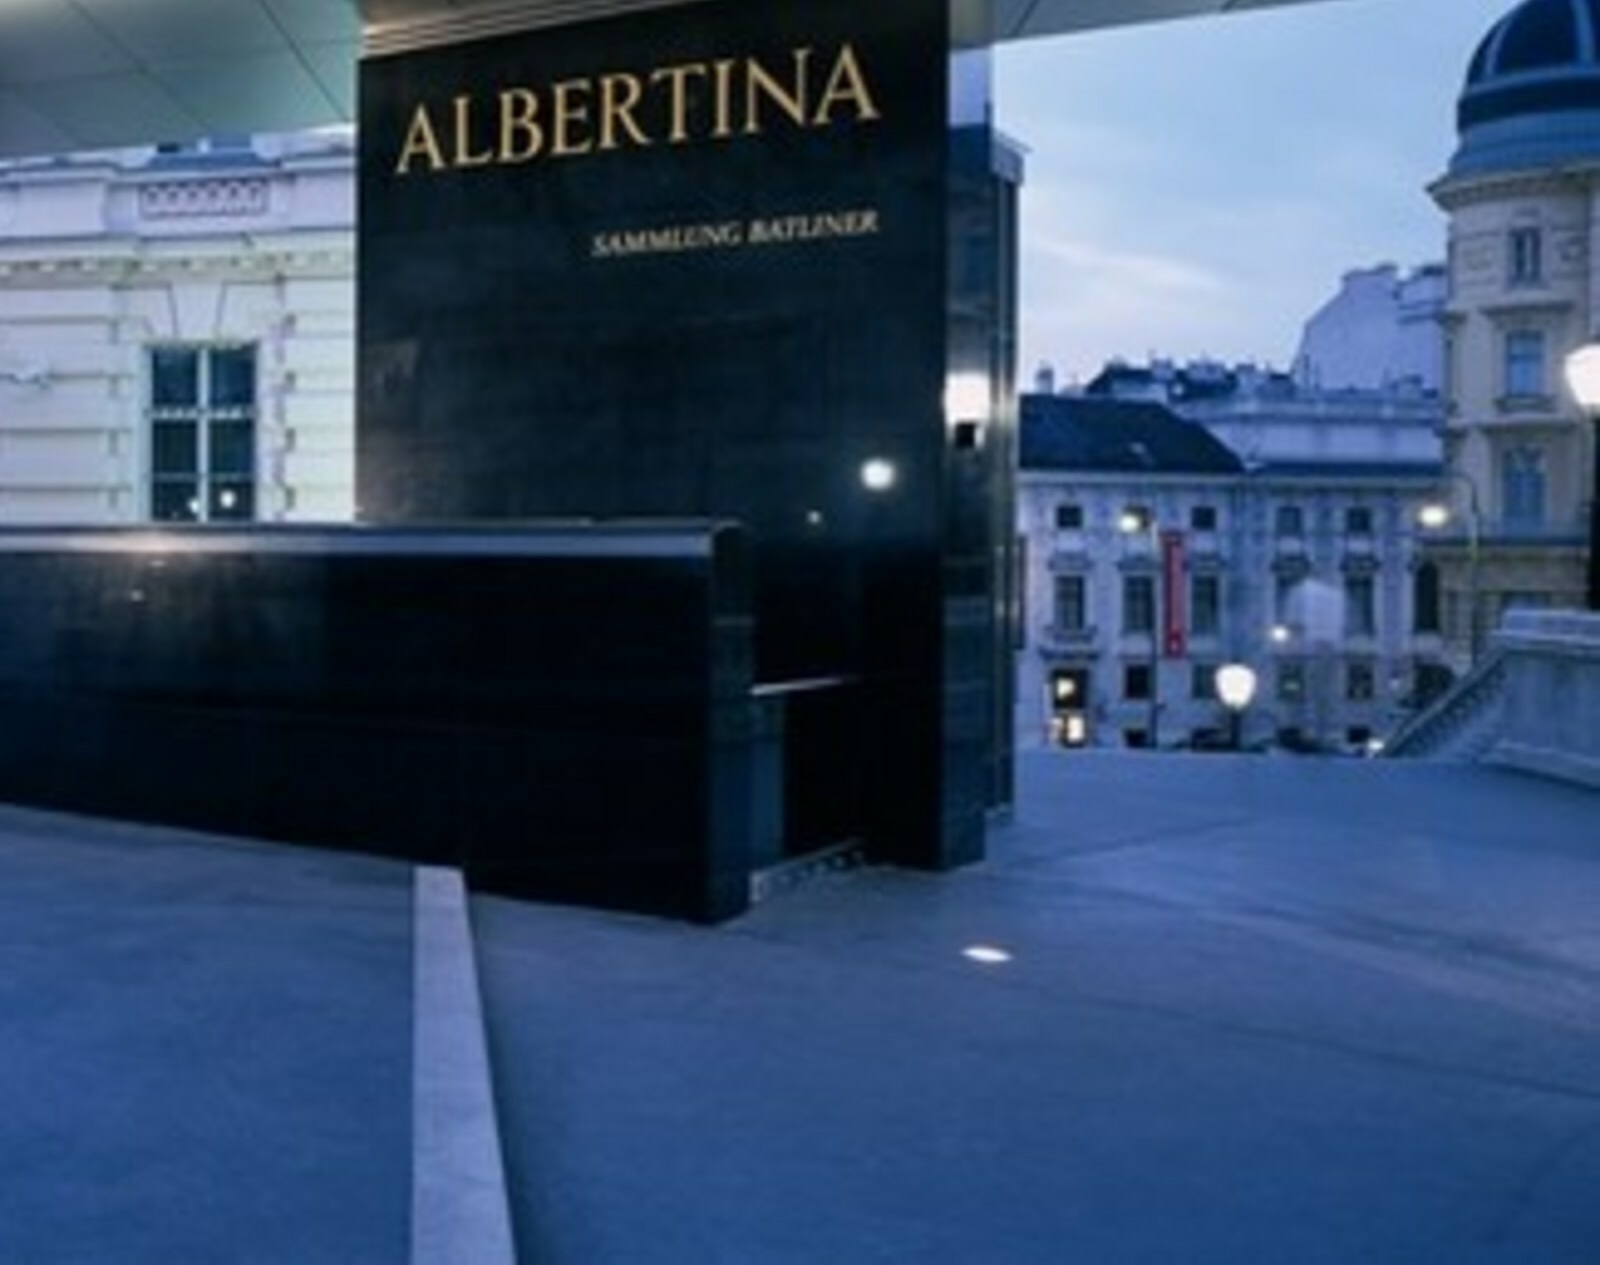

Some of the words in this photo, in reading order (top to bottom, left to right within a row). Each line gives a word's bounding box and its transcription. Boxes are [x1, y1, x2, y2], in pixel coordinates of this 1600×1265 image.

[394, 42, 880, 174] ALBERTINA
[591, 221, 740, 258] SAMMLUNG
[748, 209, 878, 243] BATLINER
